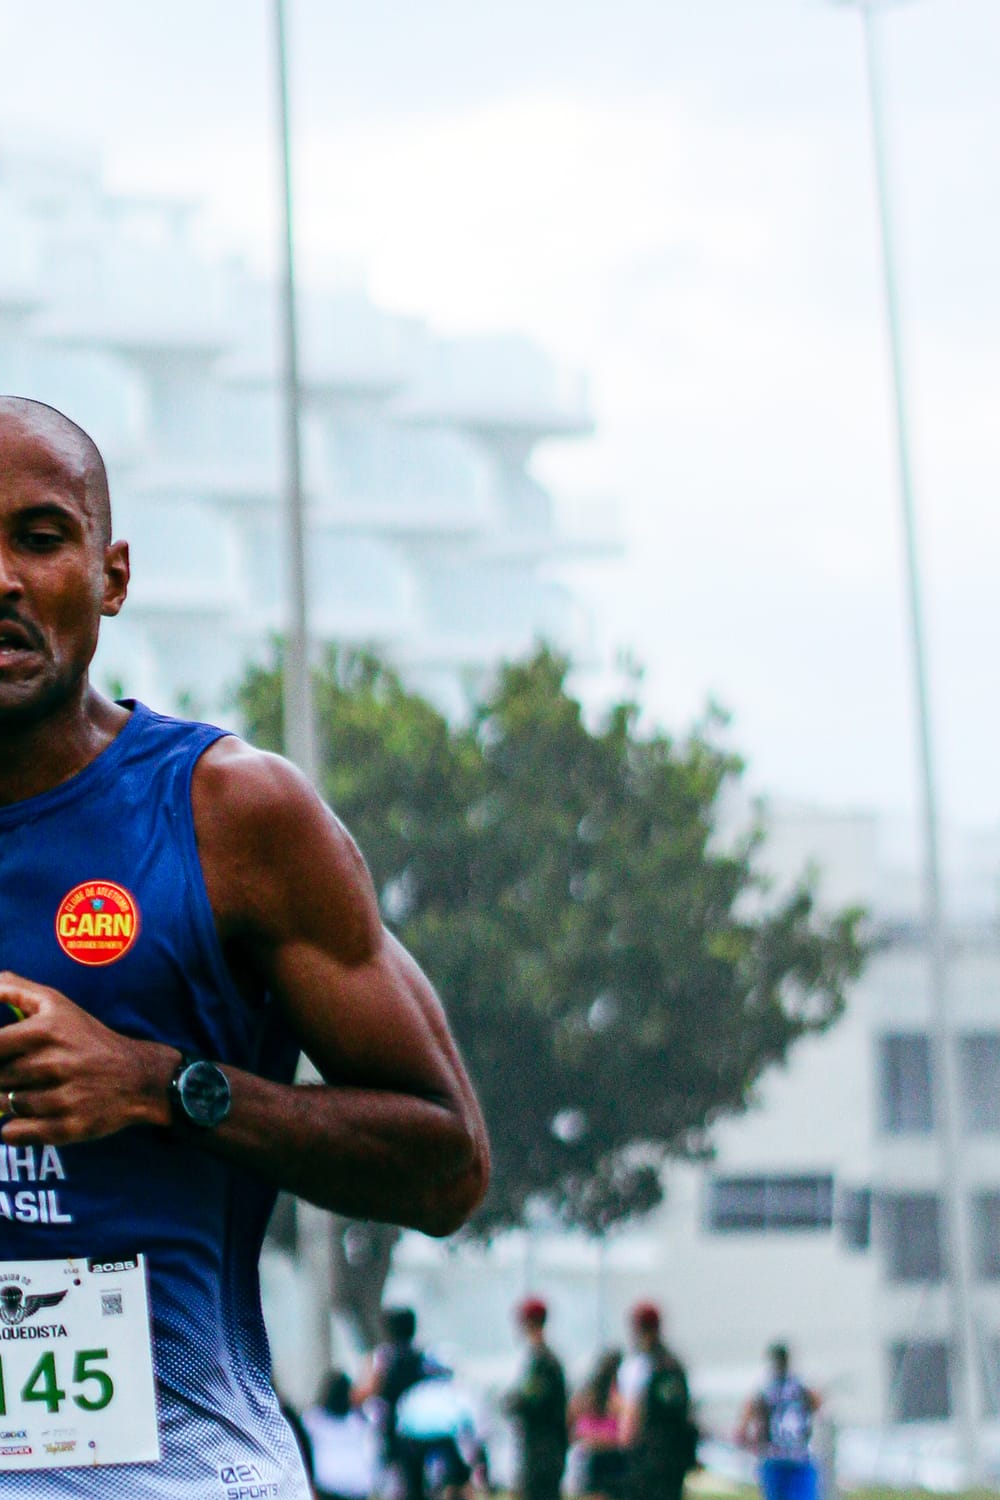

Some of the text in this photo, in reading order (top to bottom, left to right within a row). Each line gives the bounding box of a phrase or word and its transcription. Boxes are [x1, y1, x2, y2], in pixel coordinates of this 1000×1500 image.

[59, 913, 131, 937] CARN
[91, 1260, 136, 1273] 2025
[227, 1483, 278, 1500] SPORTS
